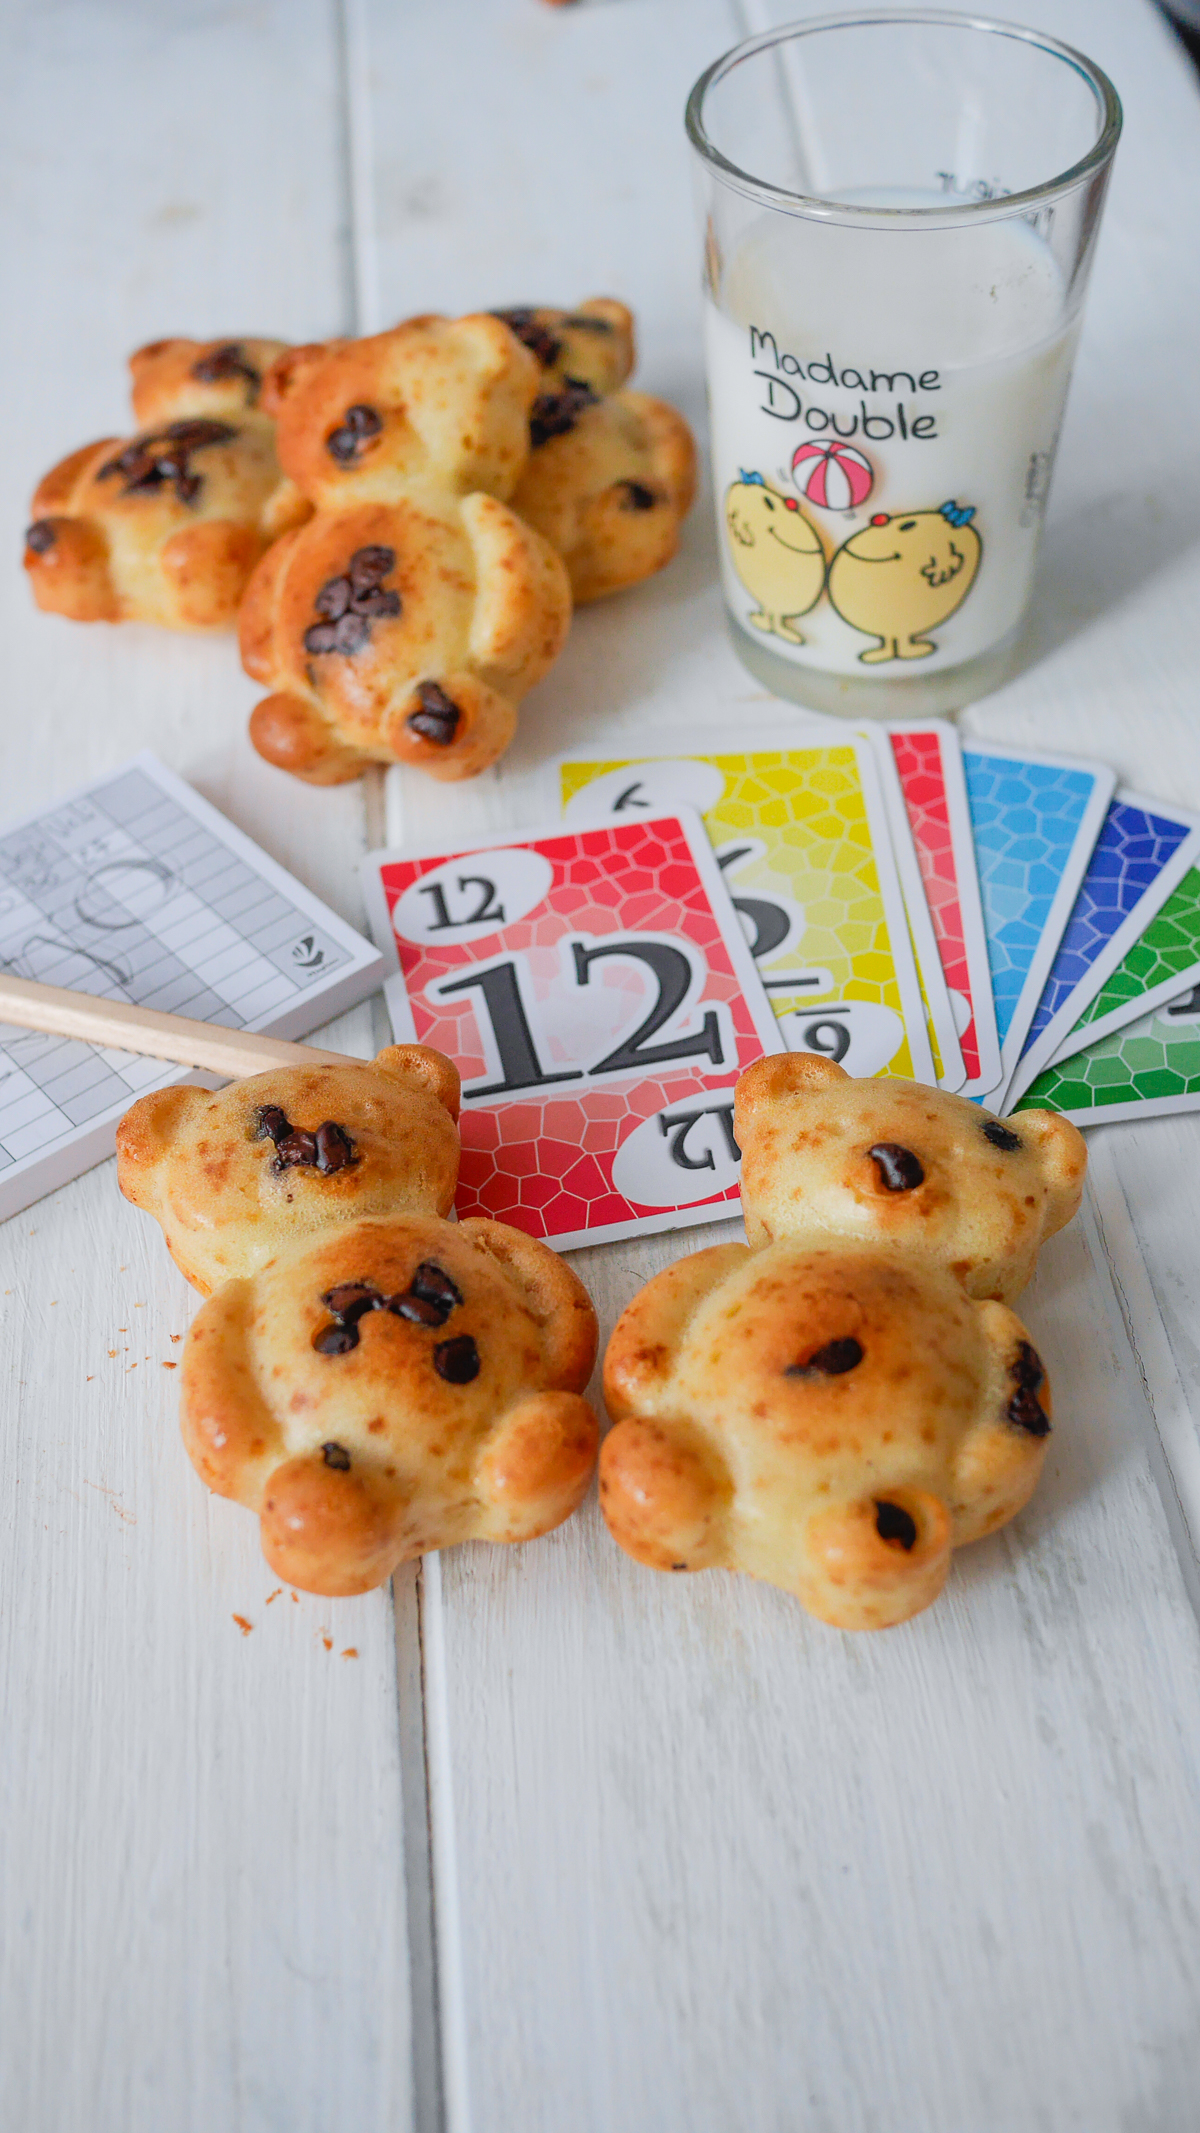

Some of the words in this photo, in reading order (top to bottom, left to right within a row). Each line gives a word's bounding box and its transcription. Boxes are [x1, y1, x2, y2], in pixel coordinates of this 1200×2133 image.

[749, 325, 941, 394] Madame
[754, 370, 938, 440] Double
[419, 876, 506, 932] 12
[438, 941, 725, 1099] 12
